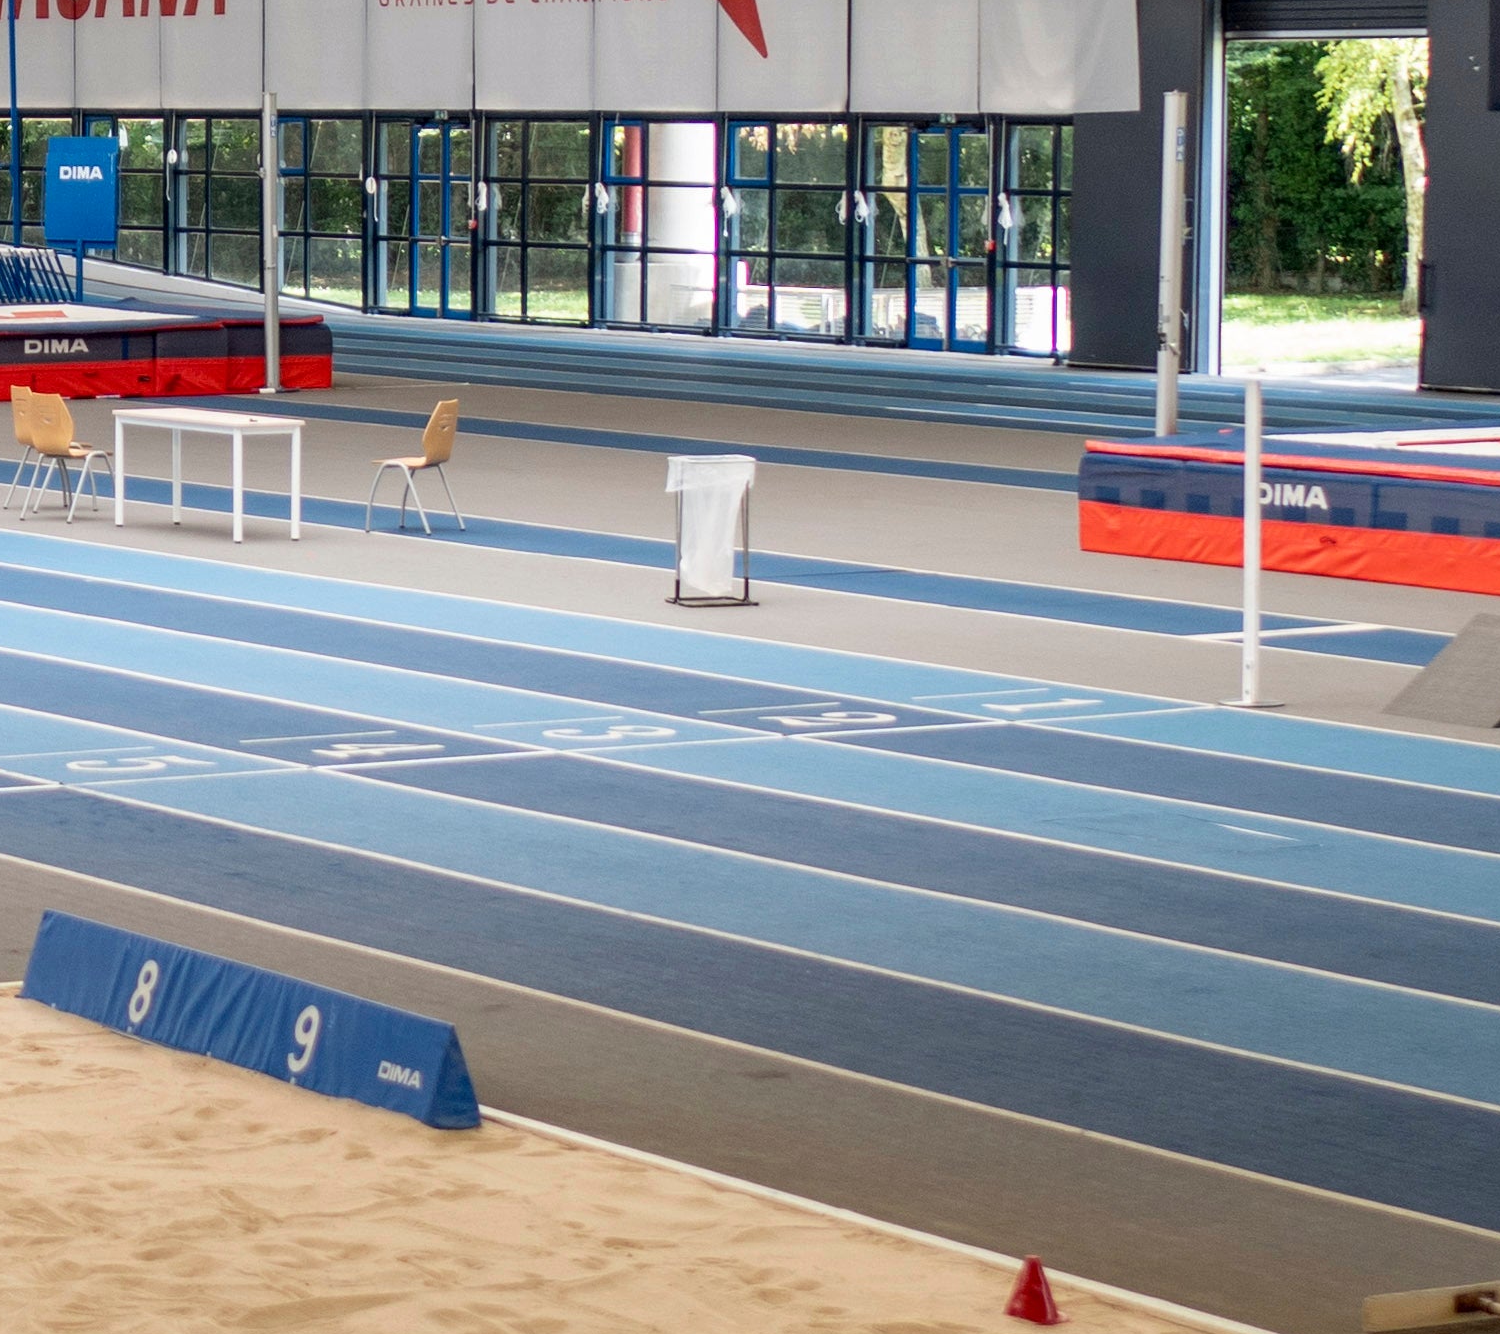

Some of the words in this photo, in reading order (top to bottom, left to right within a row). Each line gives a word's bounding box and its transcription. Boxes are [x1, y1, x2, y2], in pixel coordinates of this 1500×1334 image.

[59, 165, 104, 180] DIMA
[24, 339, 89, 354] DIMA
[1257, 481, 1329, 510] DIMA
[981, 699, 1103, 714] 1
[758, 710, 898, 727] 2
[542, 723, 677, 742] 3
[311, 742, 446, 759] 4
[66, 755, 218, 772] 5
[128, 958, 160, 1025] 8
[287, 1003, 321, 1073] 9
[377, 1059, 421, 1090] DIMA
